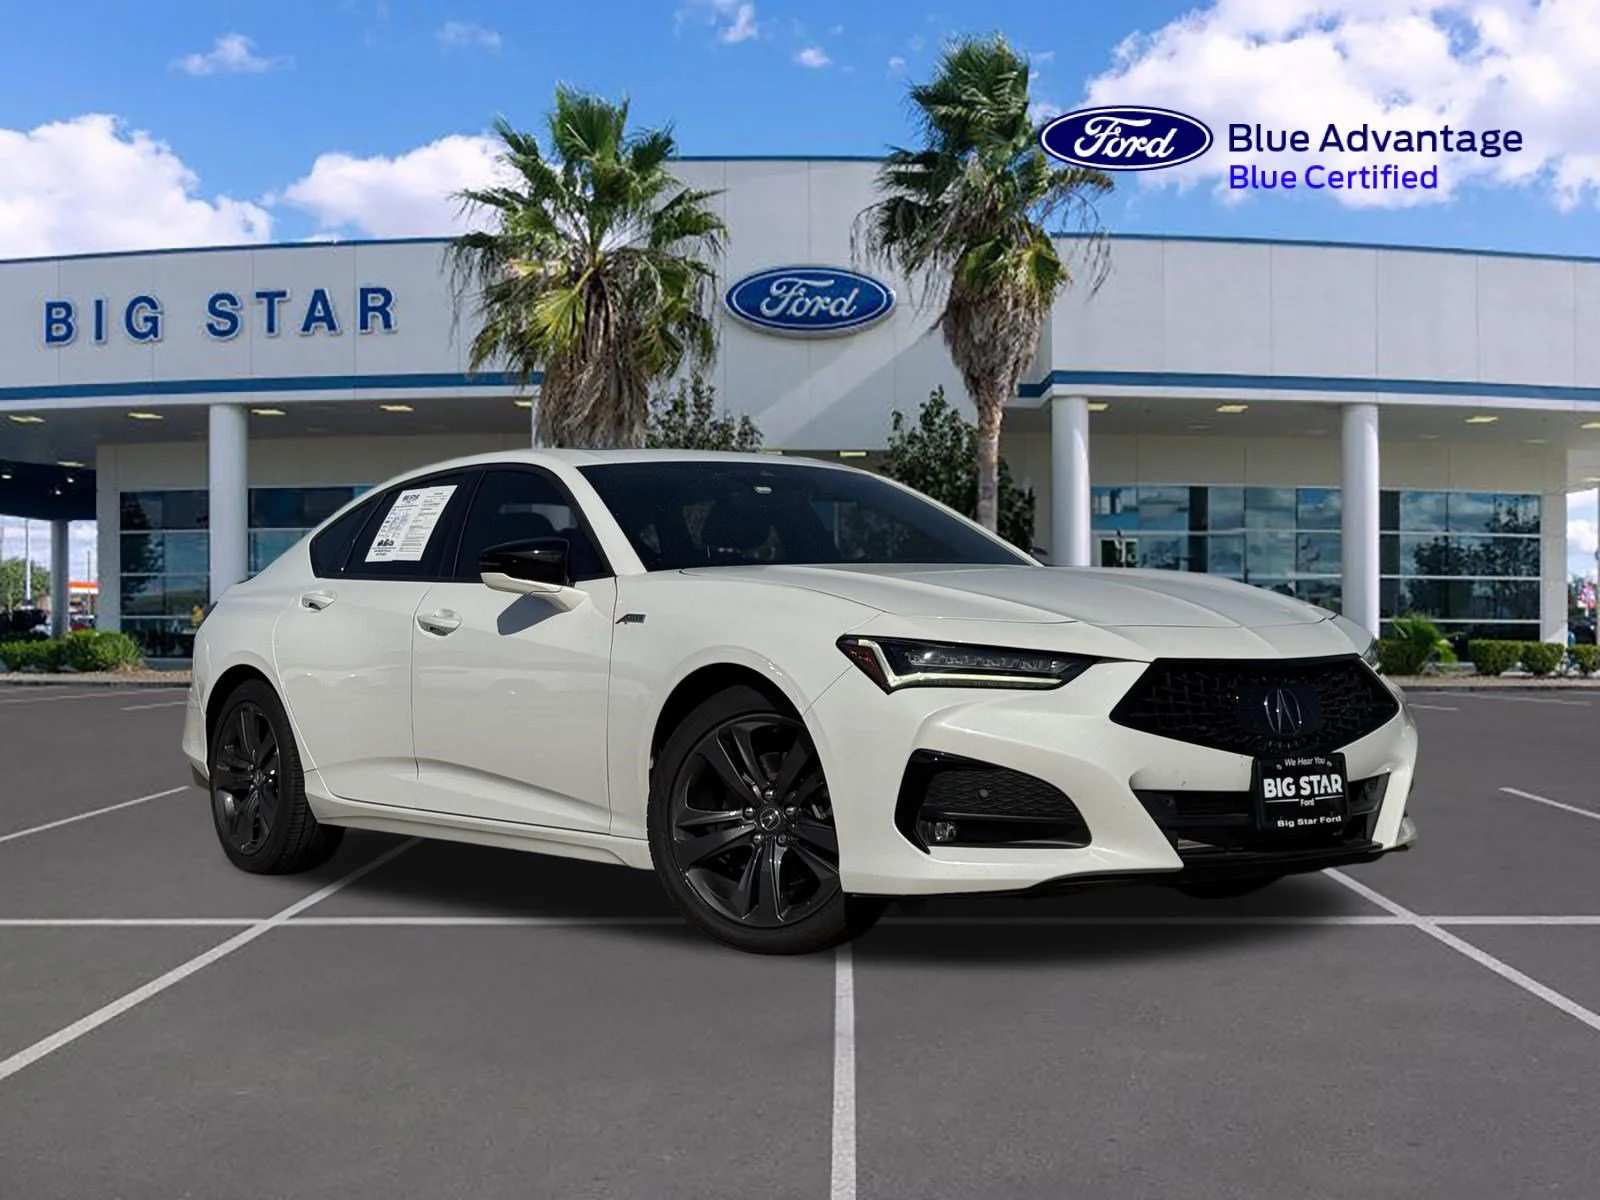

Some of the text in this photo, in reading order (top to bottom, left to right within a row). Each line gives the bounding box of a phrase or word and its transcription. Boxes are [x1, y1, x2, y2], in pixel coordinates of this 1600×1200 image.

[760, 277, 859, 318] Ford
[45, 286, 397, 345] BIG STAR
[1284, 756, 1326, 767] We Hear You
[1263, 774, 1343, 798] BIG STAR
[1300, 798, 1315, 807] Ford
[1277, 815, 1342, 828] Big Star Ford
